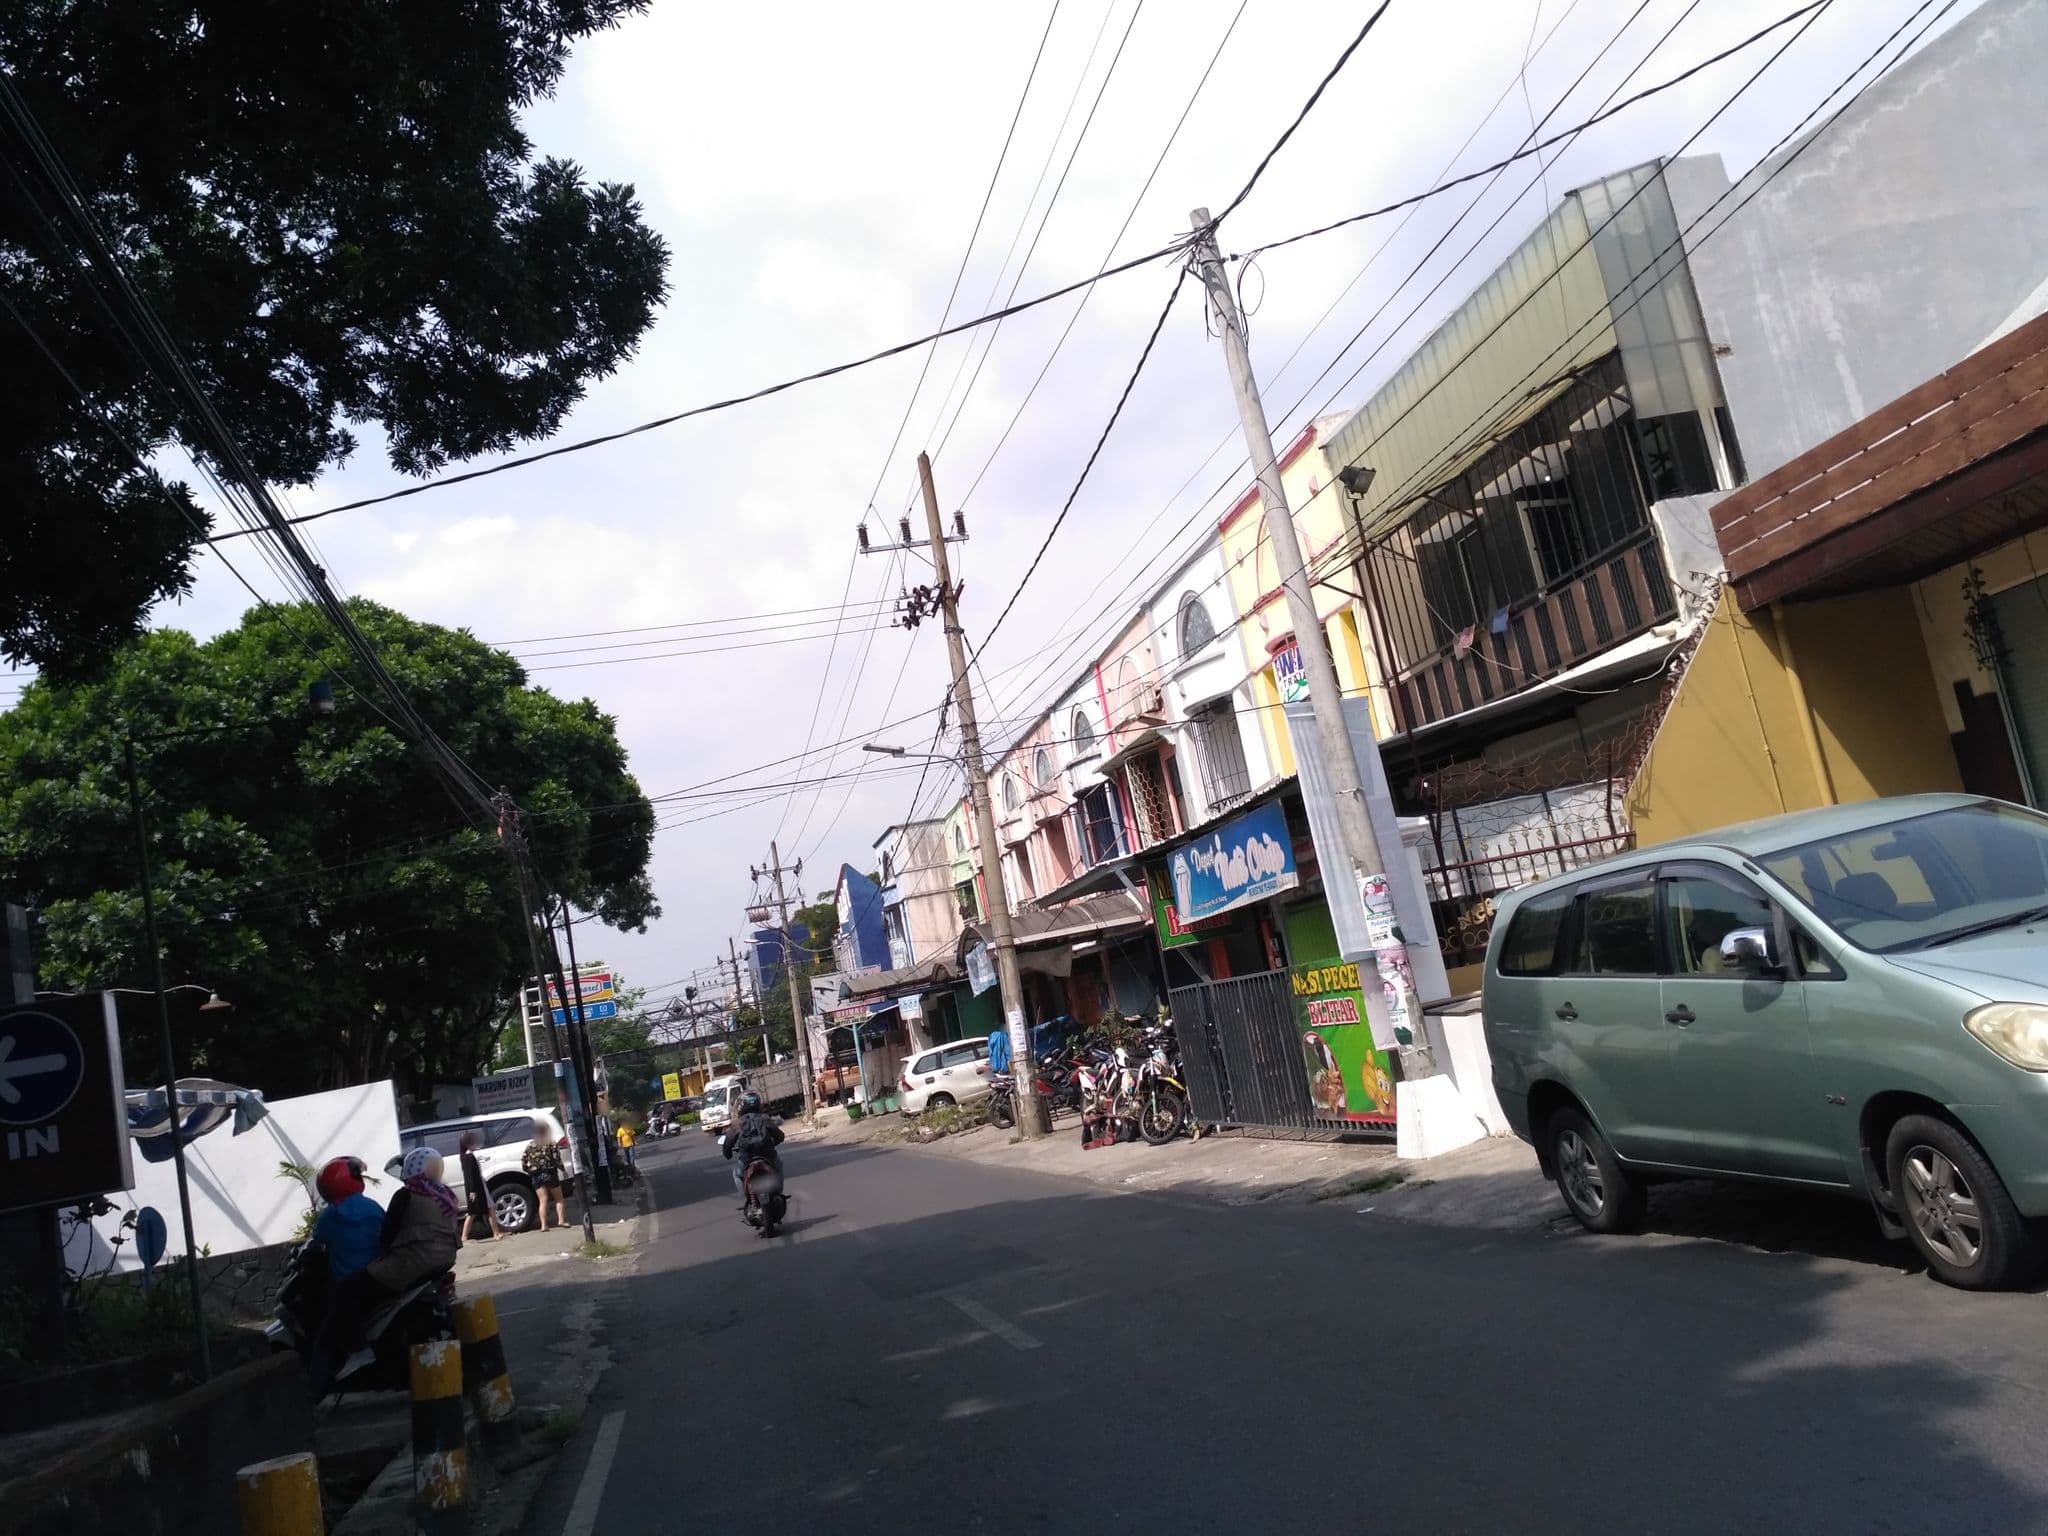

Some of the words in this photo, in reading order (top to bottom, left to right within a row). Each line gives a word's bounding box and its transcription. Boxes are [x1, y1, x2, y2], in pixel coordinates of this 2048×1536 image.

[1291, 969, 1323, 997] NASI
[1307, 997, 1361, 1028] BLITAR
[8, 1125, 59, 1160] IN
